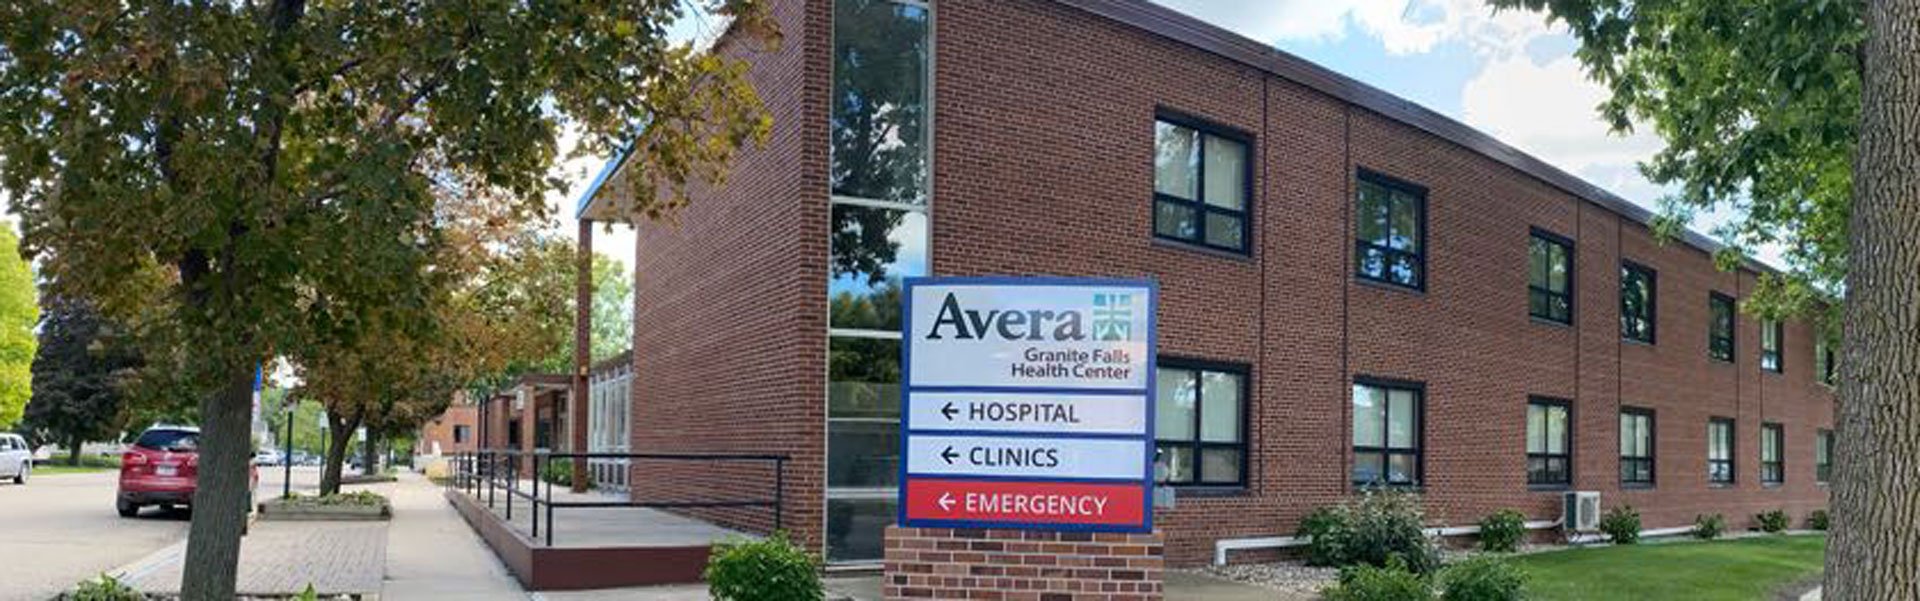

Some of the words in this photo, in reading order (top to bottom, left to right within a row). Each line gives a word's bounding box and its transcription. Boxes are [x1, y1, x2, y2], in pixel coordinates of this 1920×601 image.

[925, 292, 1086, 342] Avera
[1025, 347, 1089, 363] Granite
[1092, 349, 1131, 364] Falls
[1011, 363, 1069, 378] Health
[1072, 364, 1131, 379] Center
[969, 402, 1080, 423] HOSPITAL
[969, 446, 1059, 467] CLINICS
[965, 492, 1107, 515] EMERGENCY
